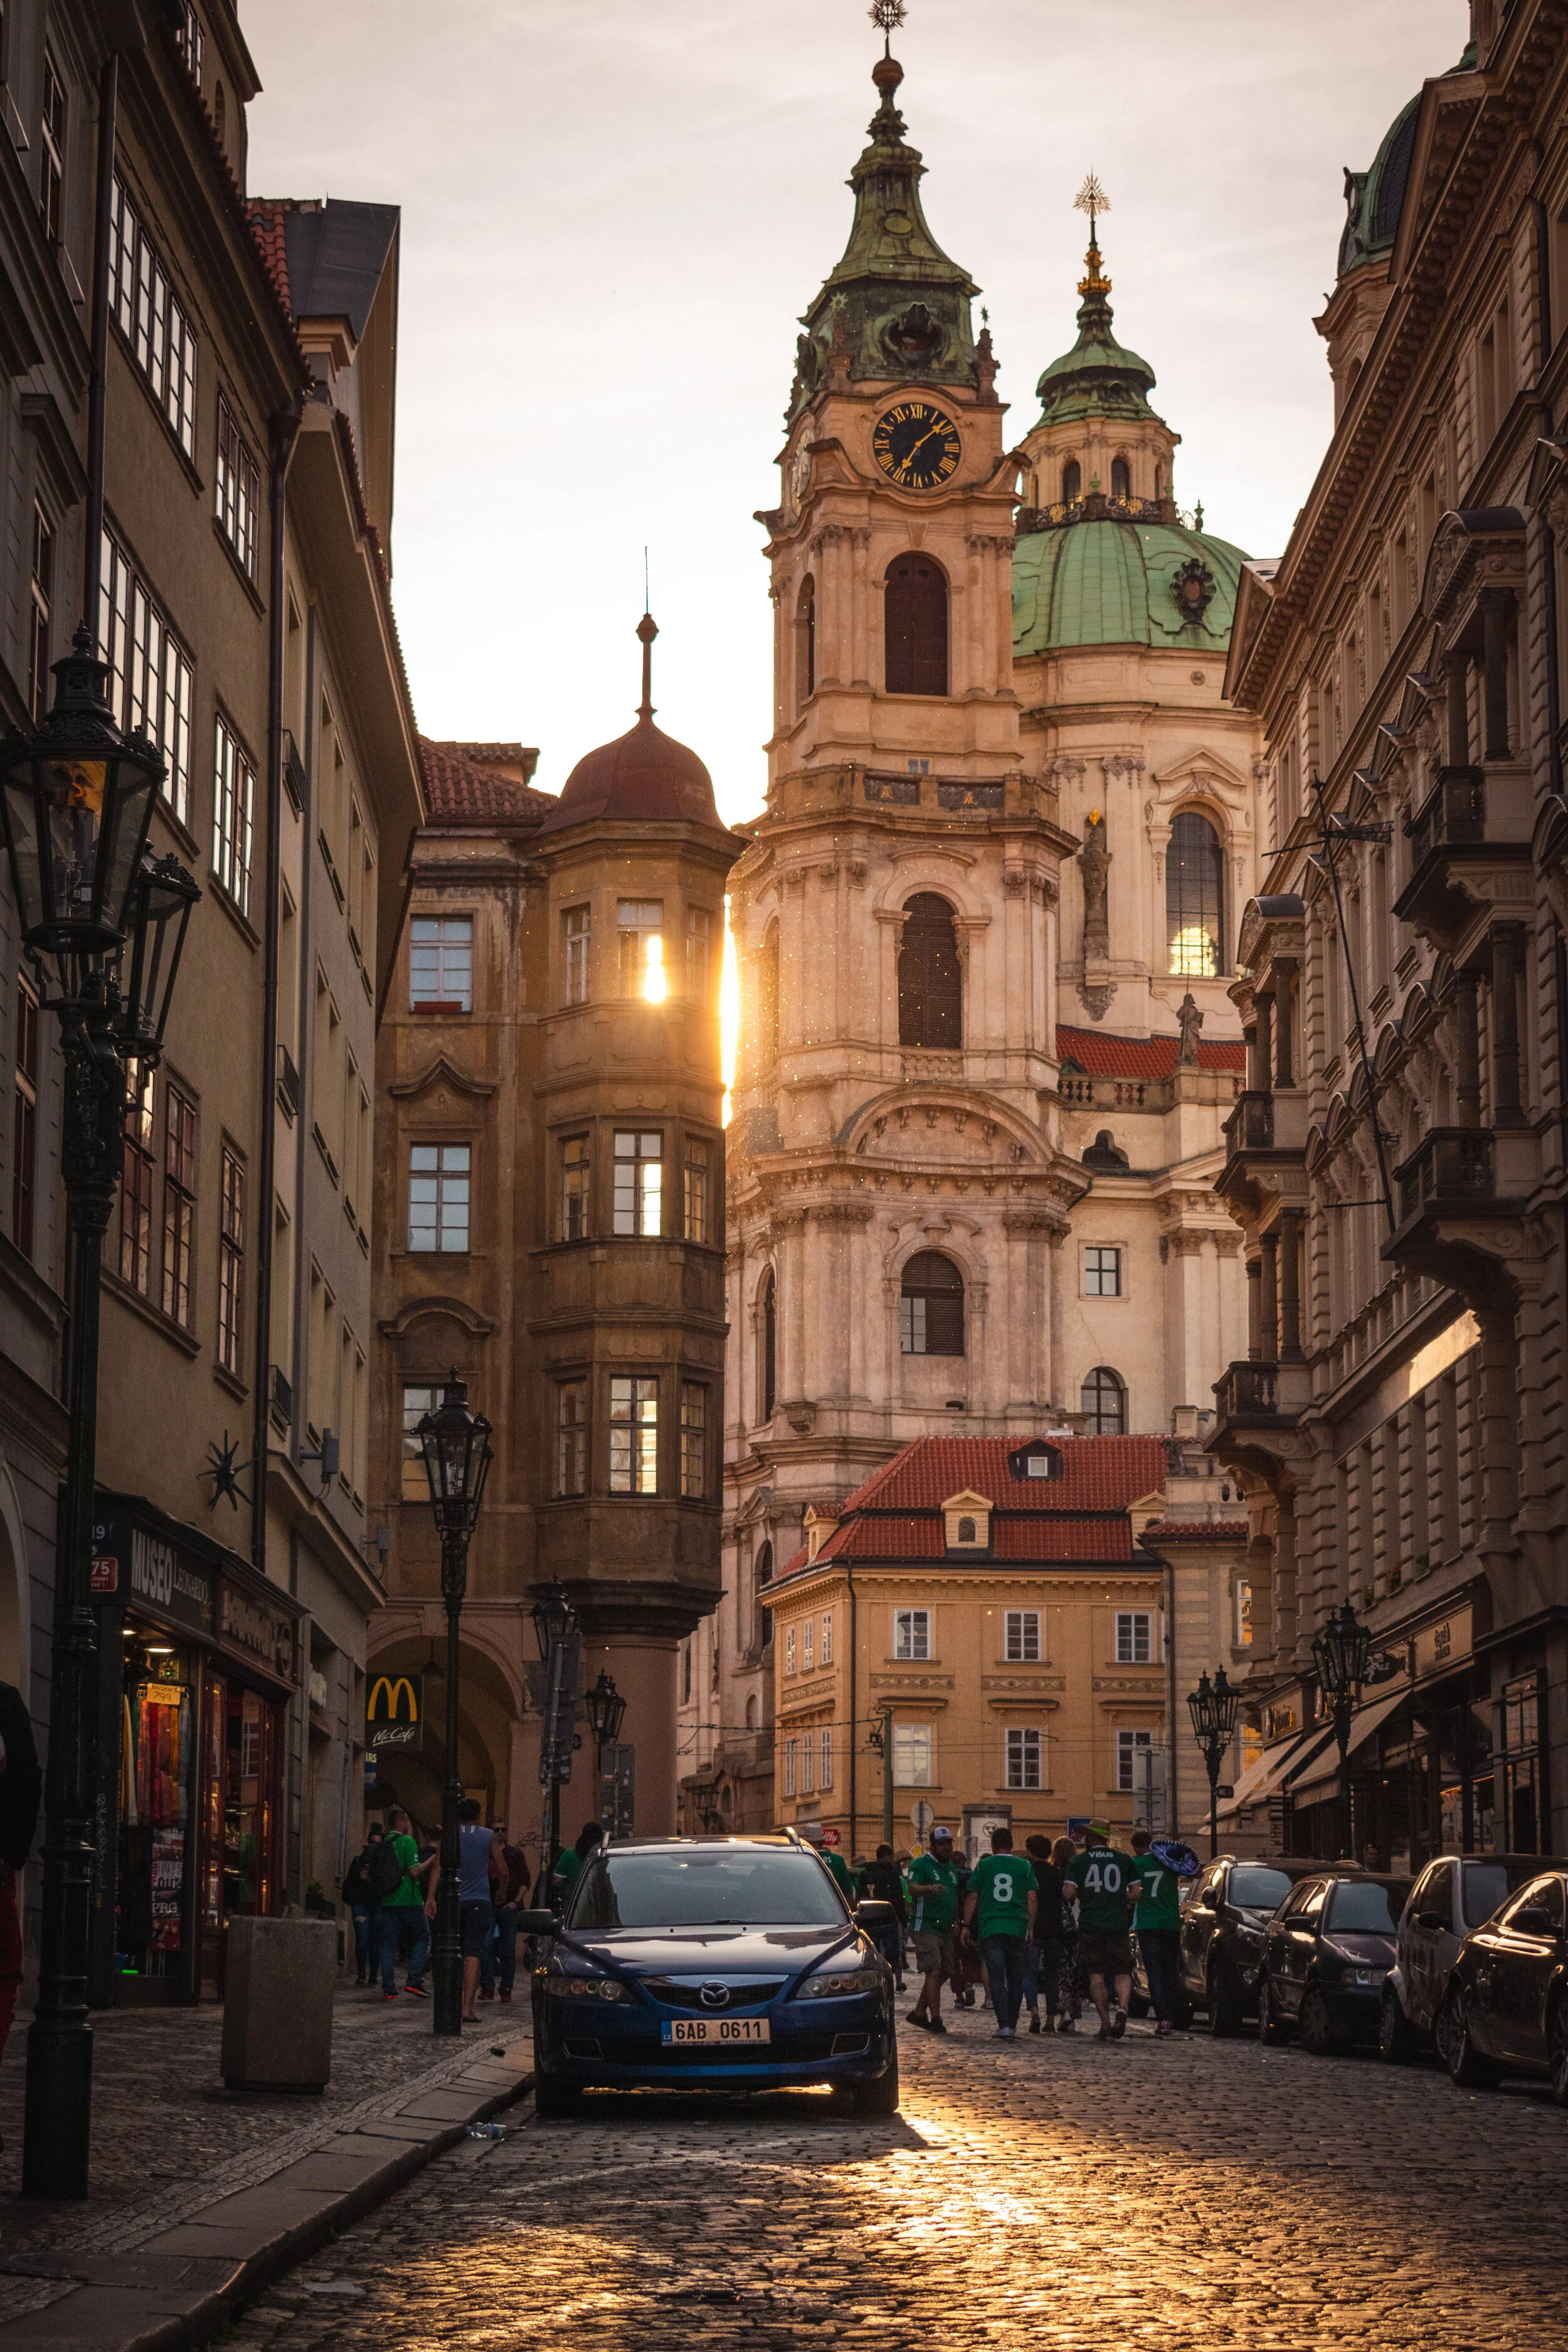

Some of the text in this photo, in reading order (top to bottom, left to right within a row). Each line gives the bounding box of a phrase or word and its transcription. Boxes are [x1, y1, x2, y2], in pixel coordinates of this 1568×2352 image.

[132, 1528, 172, 1606] MUSEO
[372, 1726, 415, 1746] McCafé
[993, 1872, 1014, 1902] 8
[1084, 1863, 1121, 1894] 40
[1144, 1870, 1164, 1897] 7
[152, 1902, 178, 1914] PRG
[675, 2021, 761, 2039] 6AB 0611
